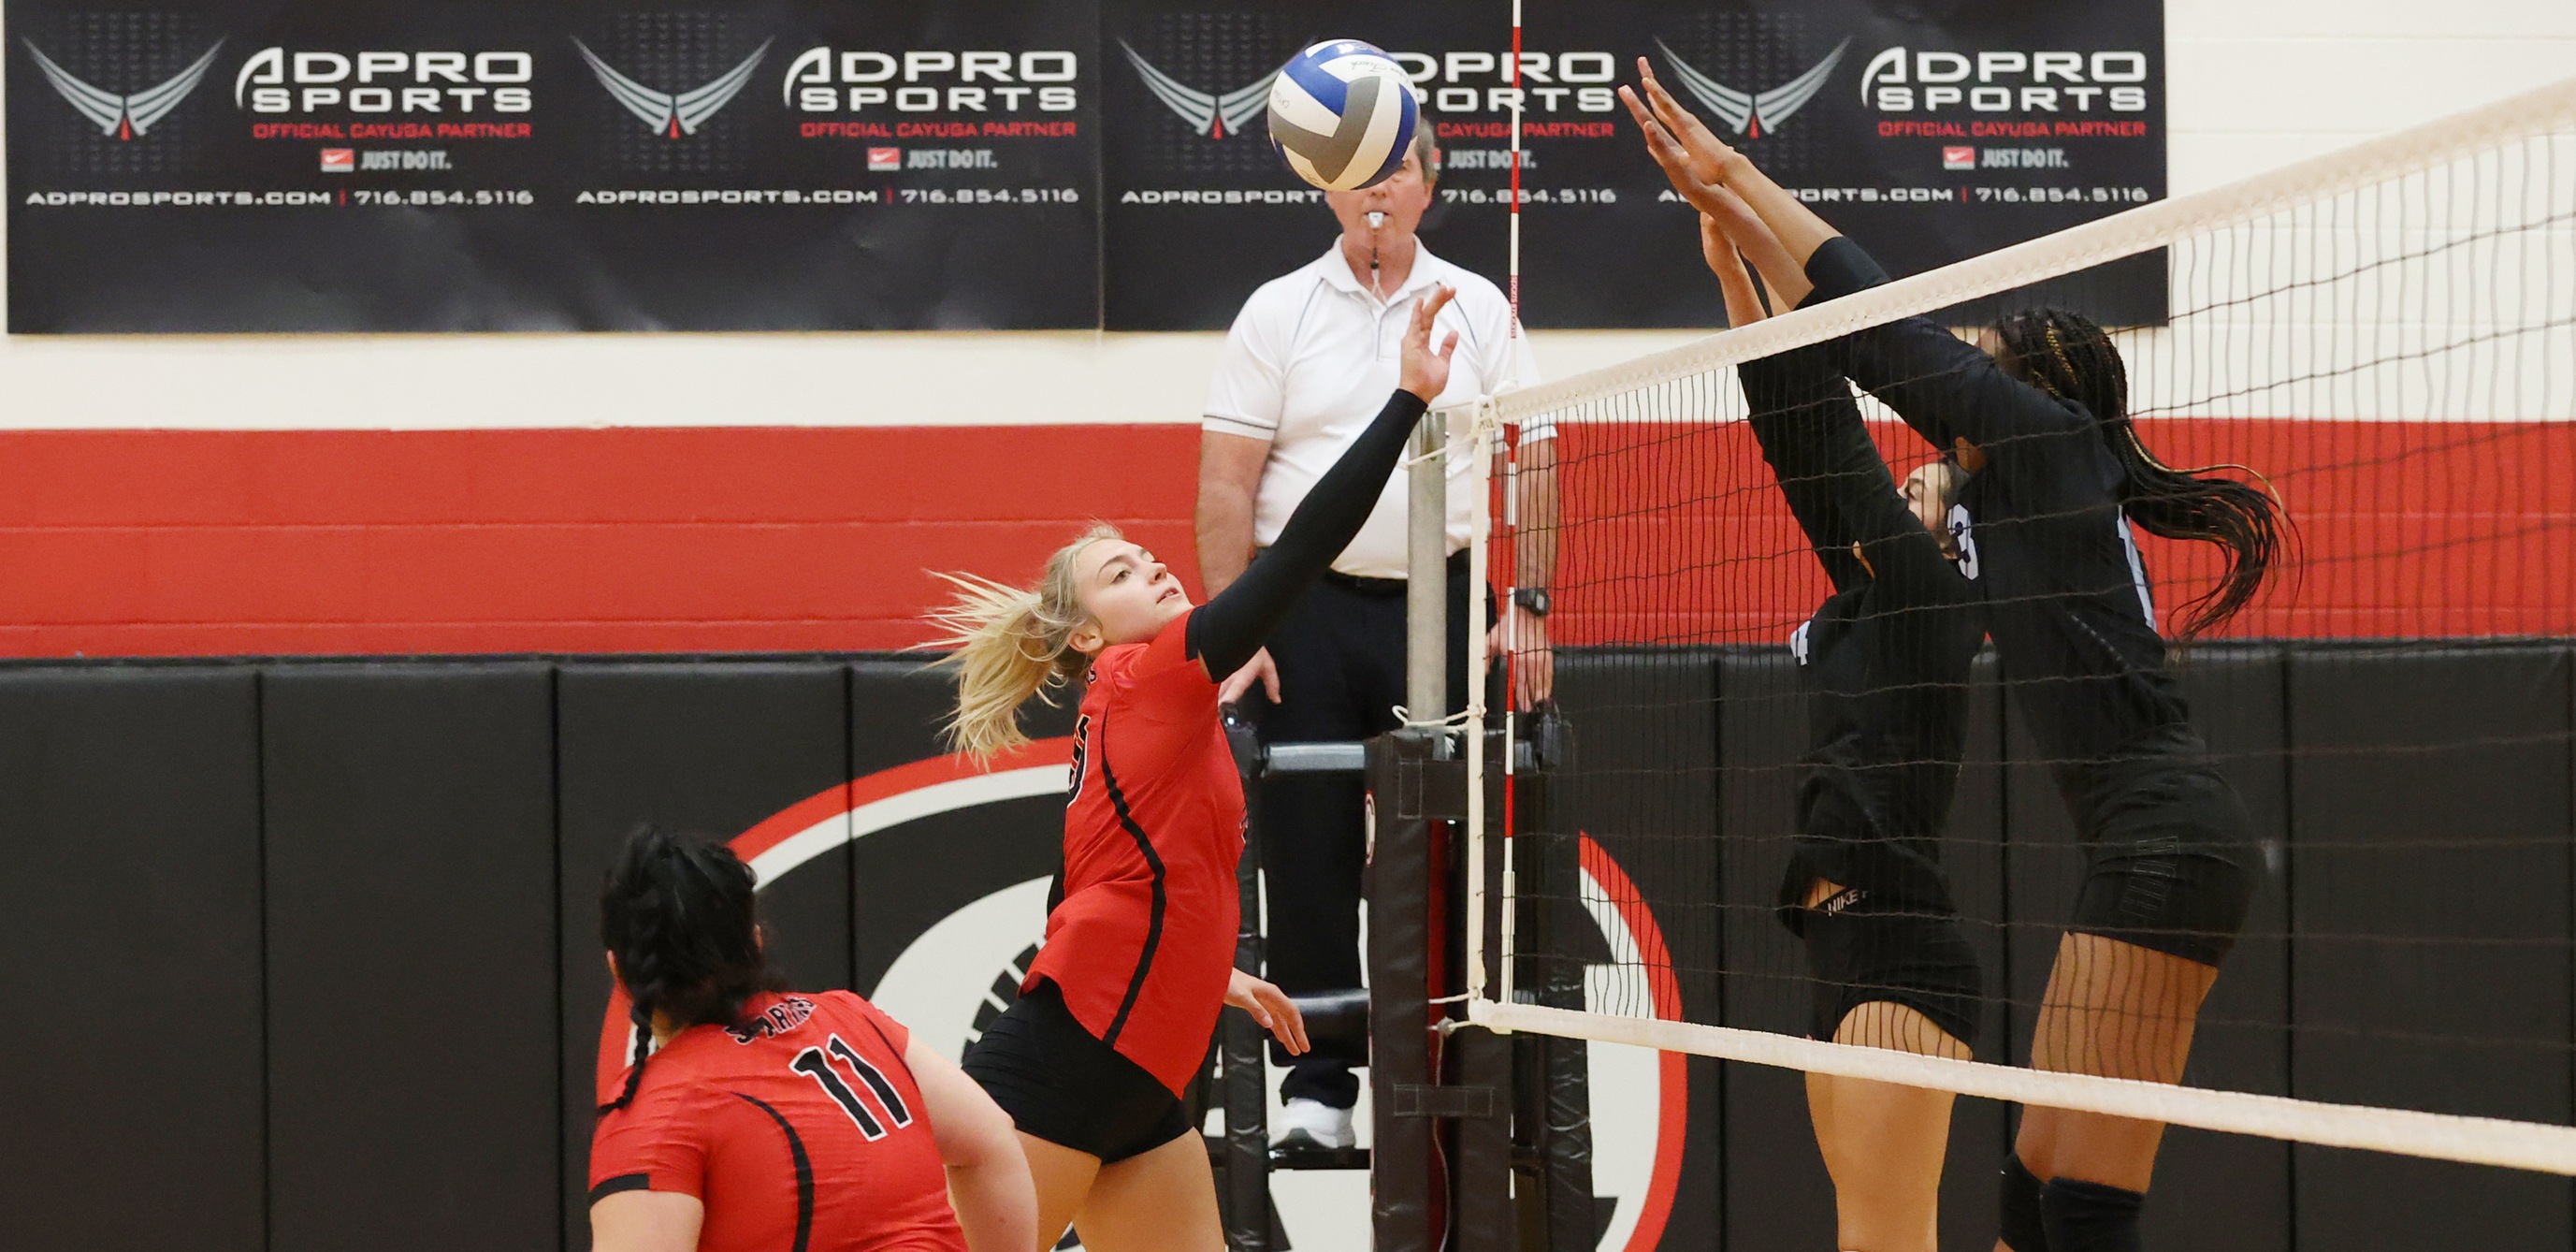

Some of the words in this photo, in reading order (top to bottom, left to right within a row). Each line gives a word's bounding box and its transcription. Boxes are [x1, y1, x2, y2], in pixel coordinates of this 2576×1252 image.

[1392, 51, 1615, 83] DPRO
[236, 47, 532, 109] ADPRO
[783, 47, 1078, 108] ADPRO
[1860, 47, 2147, 108] ADPRO
[253, 88, 532, 112] SPORTS
[801, 87, 1077, 111] SPORTS
[1878, 87, 2147, 111] SPORTS
[253, 123, 344, 138] OFFICIAL
[349, 123, 433, 138] CAYUGA
[437, 123, 532, 138] PARTNER
[801, 122, 891, 138] OFFICIAL
[896, 122, 979, 138] CAYUGA
[983, 122, 1078, 138] PARTNER
[1522, 122, 1615, 138] PARTNER
[1878, 122, 1967, 138] OFFICIAL
[1971, 122, 2050, 138] CAYUGA
[2055, 122, 2147, 138] PARTNER
[360, 150, 401, 169] JUST
[402, 150, 428, 169] DO
[430, 150, 453, 169] IT.
[906, 150, 947, 168] JUST
[948, 150, 974, 168] DO
[976, 150, 998, 168] IT.
[1447, 150, 1486, 169] JUST
[1982, 149, 2020, 168] JUST
[2020, 149, 2046, 168] DO
[2048, 149, 2070, 168] IT.
[25, 191, 331, 205] ADPROSPORTS.COM
[354, 190, 534, 205] 716.854.5116
[576, 190, 878, 204] ADPROSPORTS.COM
[901, 189, 1079, 204] 716.854.5116
[1122, 190, 1323, 204] ADPROSPORT
[1975, 188, 2149, 203] 716.854.5116
[1827, 888, 1859, 917] NIKE
[789, 1032, 913, 1143] 11
